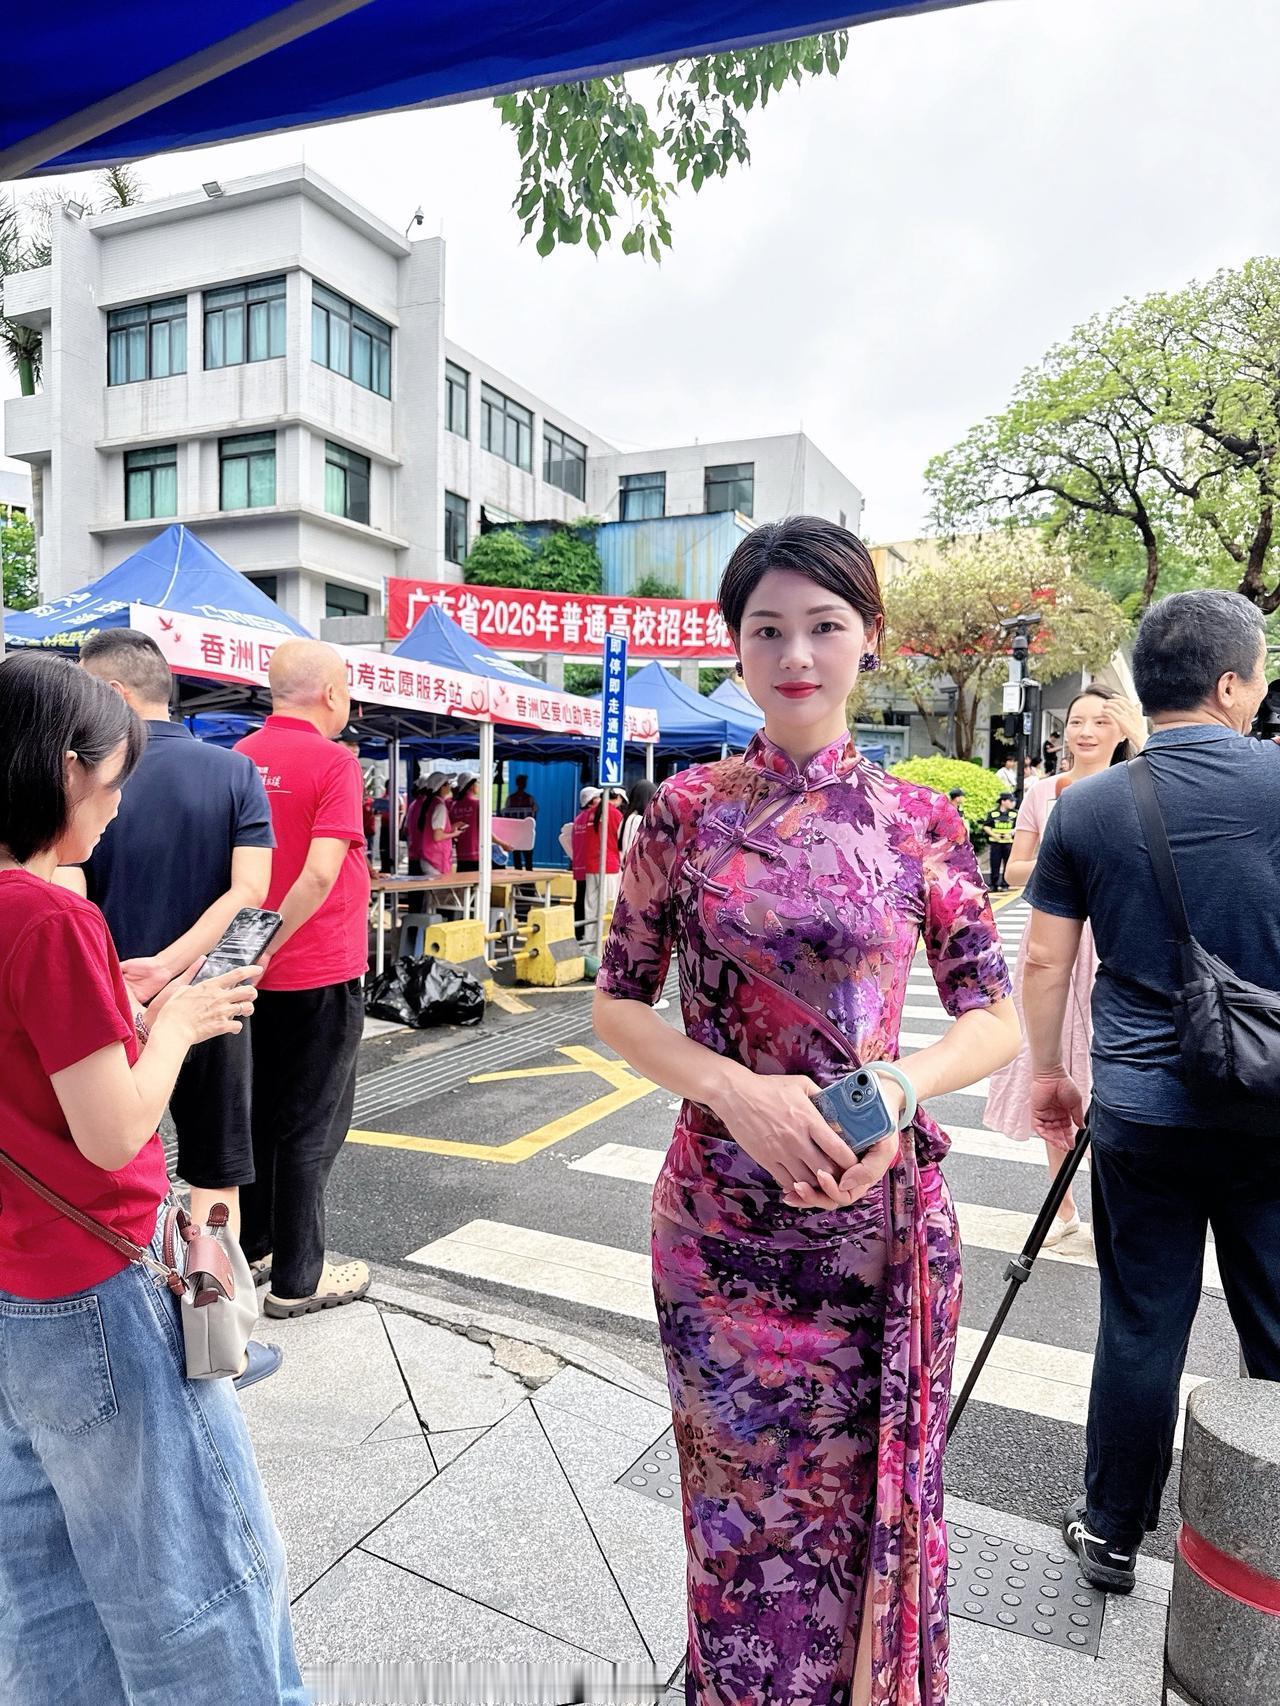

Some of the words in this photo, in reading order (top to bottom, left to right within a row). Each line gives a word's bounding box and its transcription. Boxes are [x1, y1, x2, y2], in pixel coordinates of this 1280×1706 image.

[201, 633, 462, 705] 香洲区考志愿服务站
[606, 638, 621, 753] 即停即走通道
[516, 695, 638, 732] 香洲区爱心助考志站
